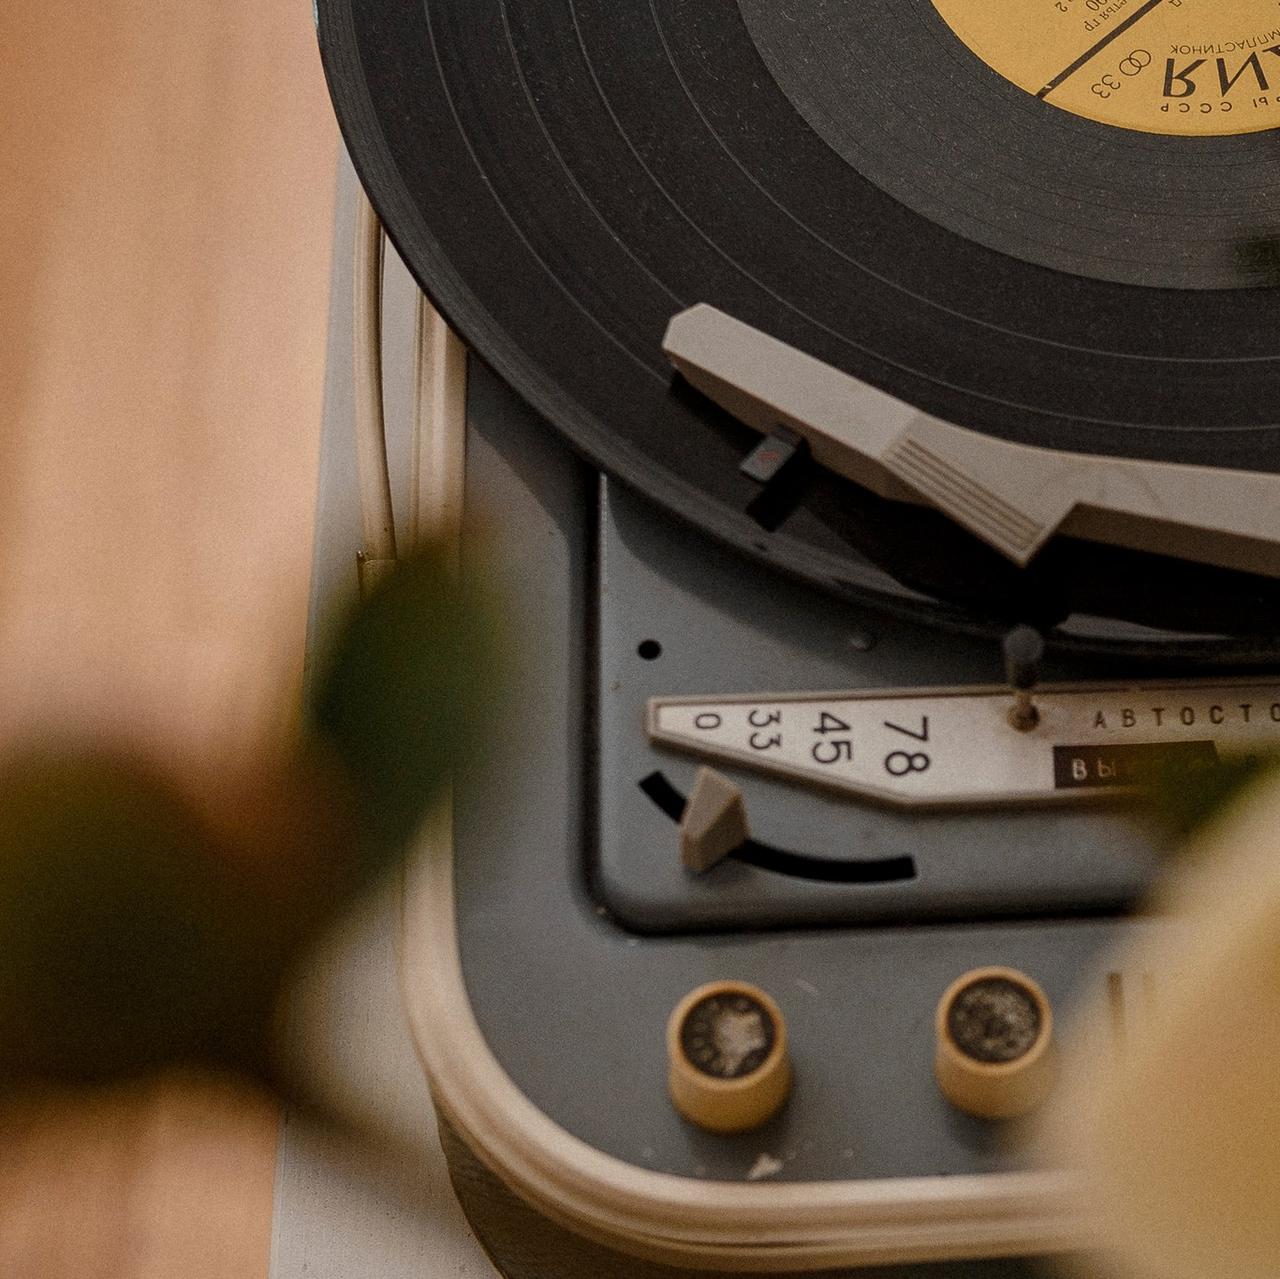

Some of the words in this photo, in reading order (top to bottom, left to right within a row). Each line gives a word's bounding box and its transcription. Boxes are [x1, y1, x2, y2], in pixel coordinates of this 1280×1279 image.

[1053, 0, 1068, 13] 2
[1082, 17, 1102, 32] гр
[1089, 72, 1121, 99] 33
[1159, 100, 1233, 114] СССР
[694, 712, 722, 730] 0
[748, 709, 781, 750] 33
[812, 711, 852, 764] 45
[883, 715, 930, 776] 78
